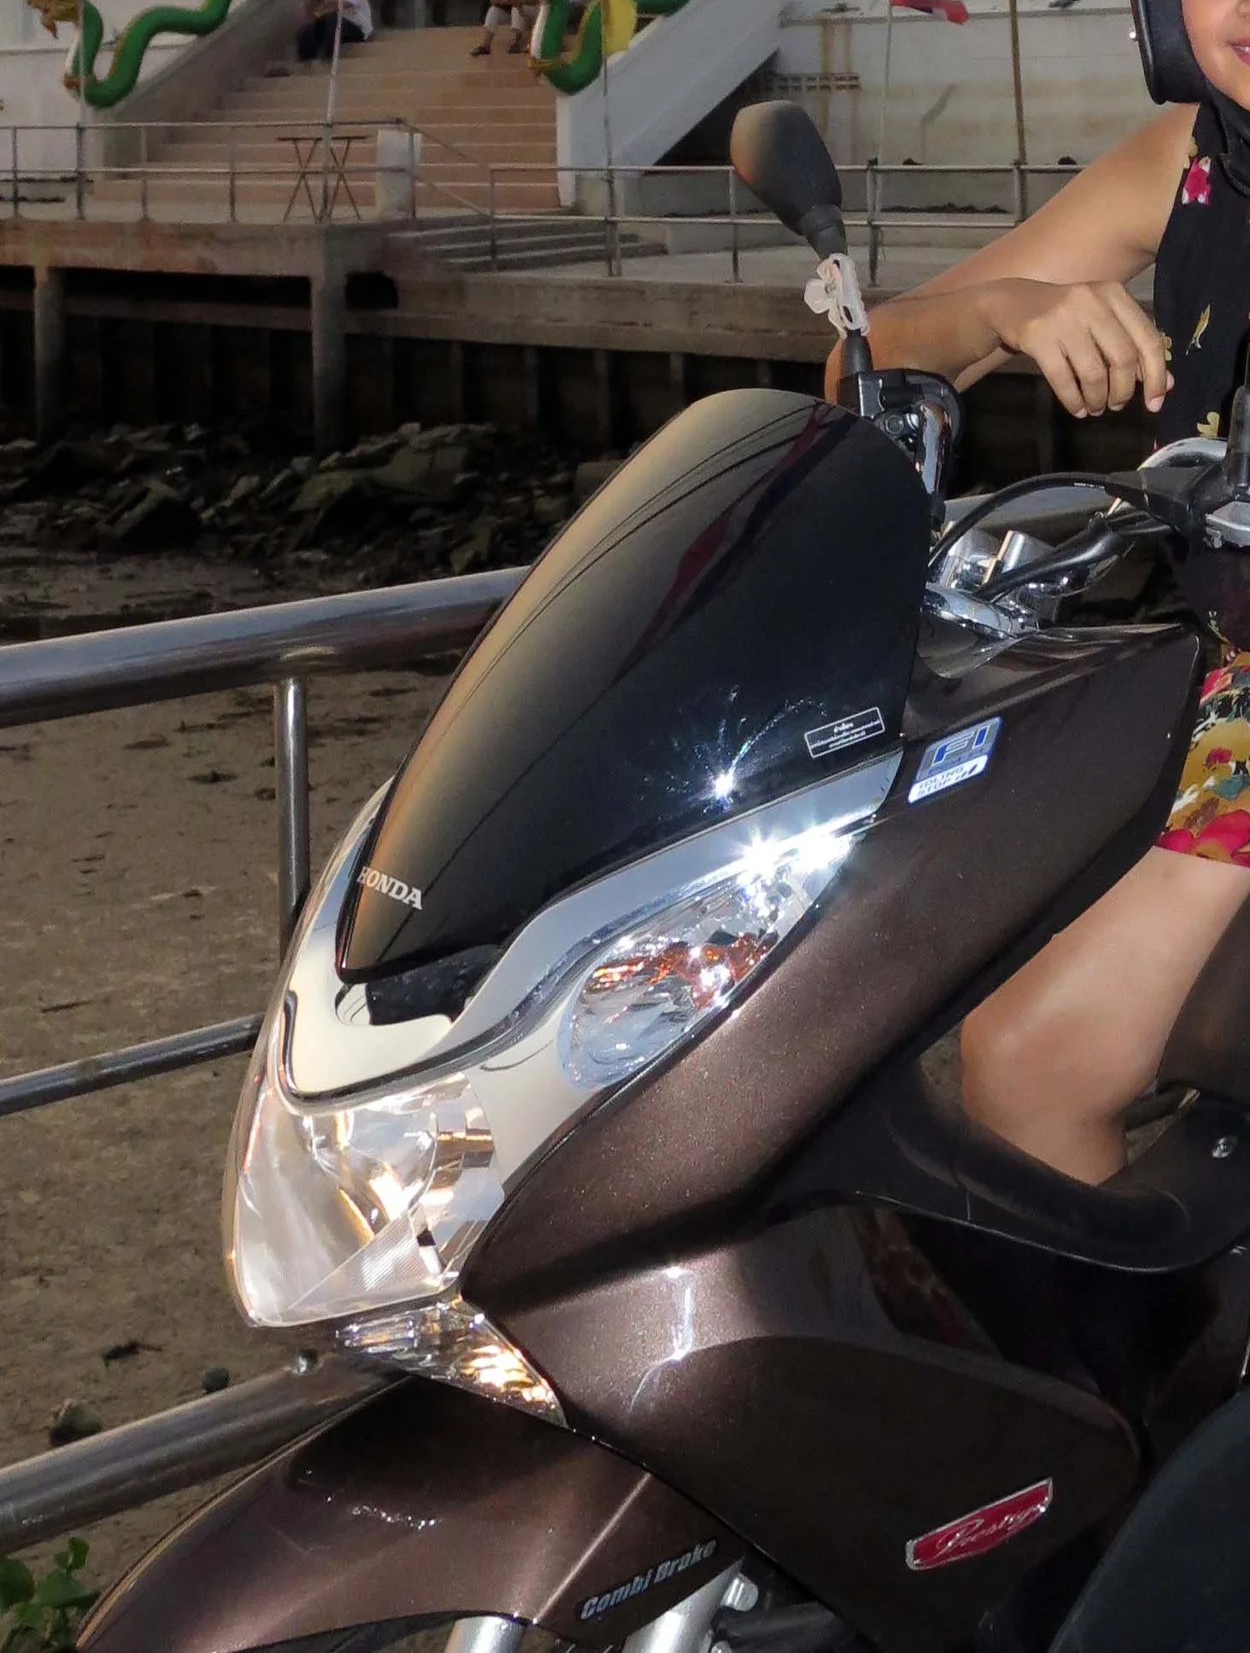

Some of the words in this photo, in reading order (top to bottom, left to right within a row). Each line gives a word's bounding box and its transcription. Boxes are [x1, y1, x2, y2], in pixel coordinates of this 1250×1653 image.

[931, 725, 990, 767] FI
[919, 765, 964, 790] IDLING
[357, 866, 423, 910] HONDA
[581, 1569, 653, 1619] Combi
[654, 1539, 716, 1584] Brake
